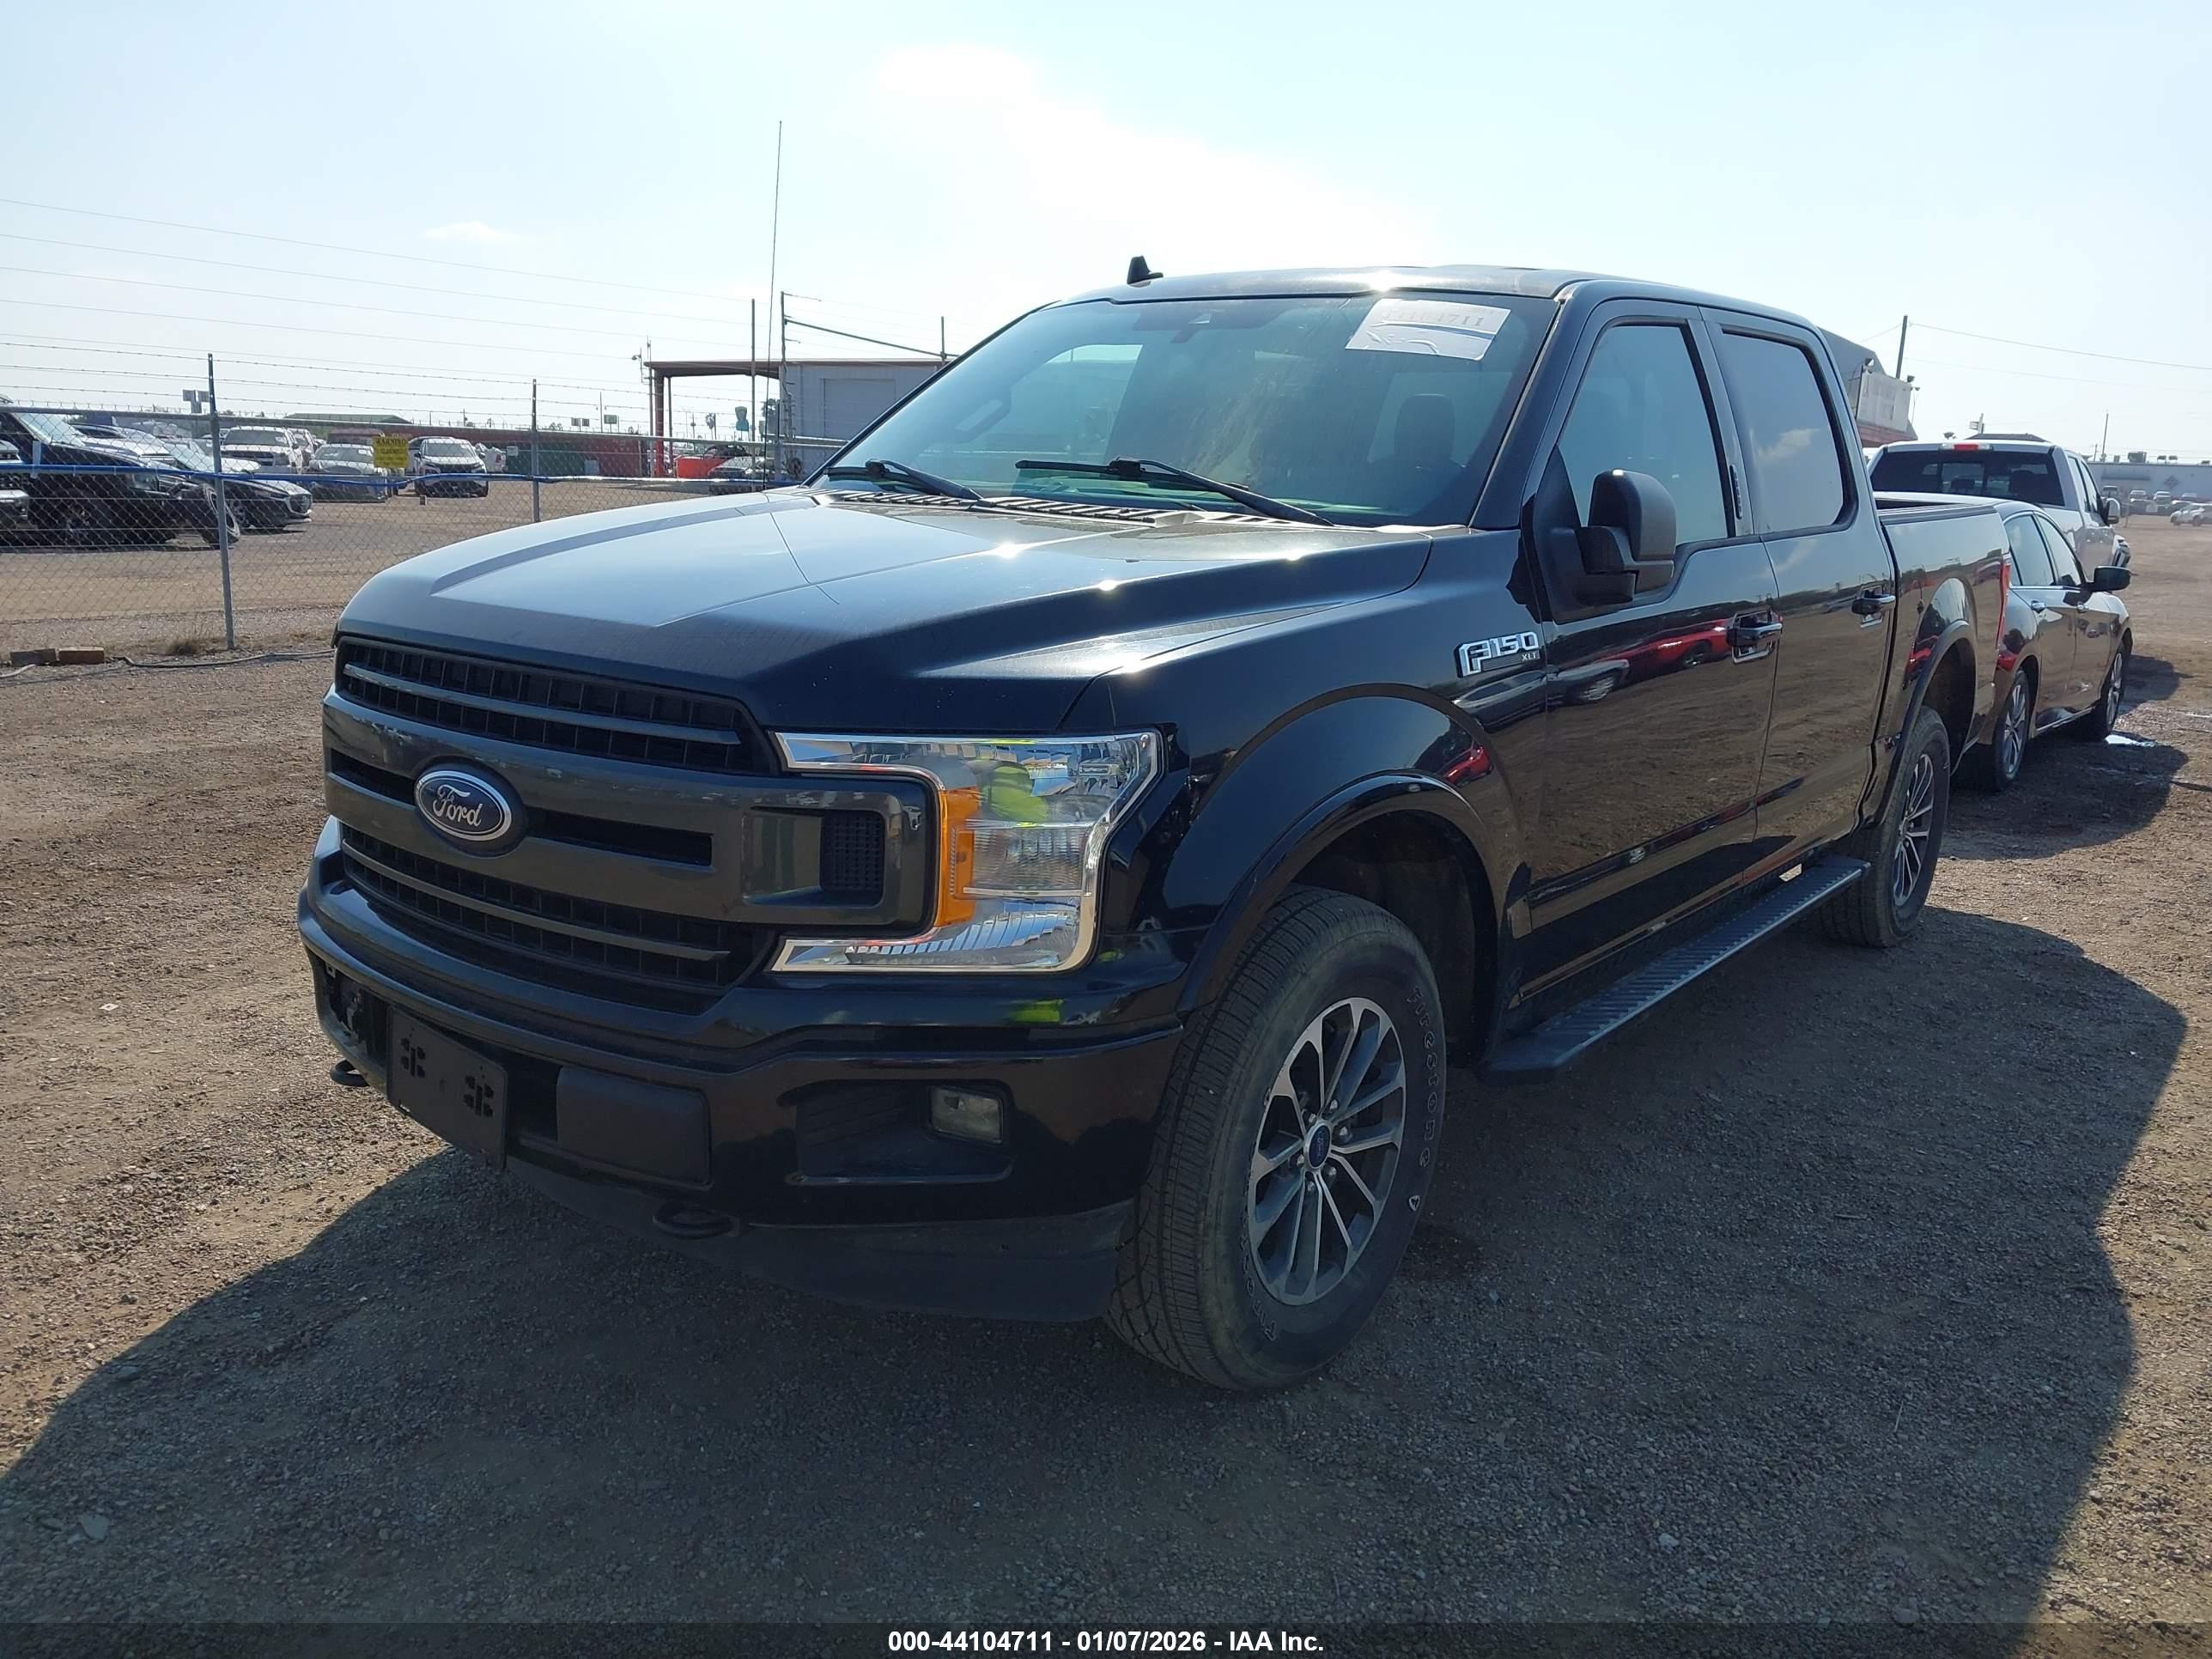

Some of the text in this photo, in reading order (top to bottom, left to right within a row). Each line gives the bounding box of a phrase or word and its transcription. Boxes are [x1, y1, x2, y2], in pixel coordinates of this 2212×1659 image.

[1521, 652, 1537, 662] XLT
[432, 784, 483, 827] Ford
[1405, 986, 1439, 1169] Firestone
